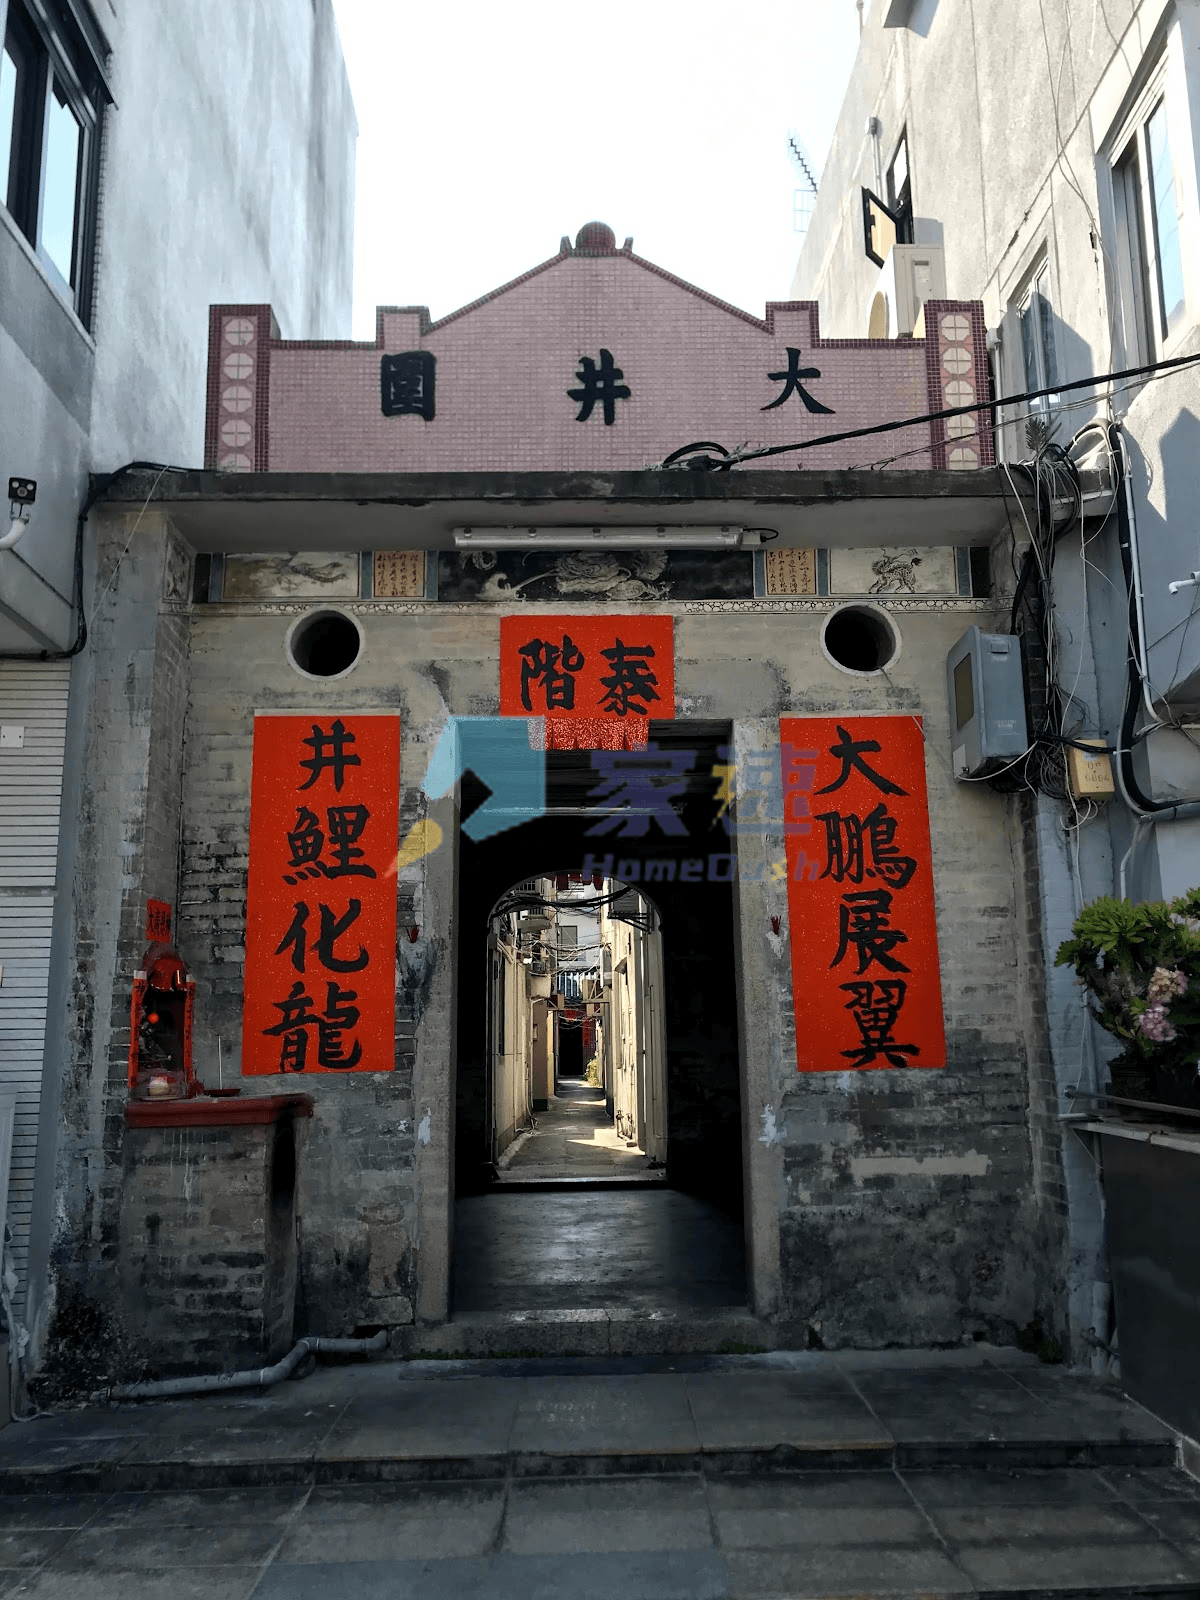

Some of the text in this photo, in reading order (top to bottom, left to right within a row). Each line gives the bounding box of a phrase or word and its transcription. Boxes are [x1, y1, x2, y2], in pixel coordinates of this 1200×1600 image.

[262, 719, 376, 1073] 井鯉化龍
[814, 725, 920, 1069] 大鵬展翼
